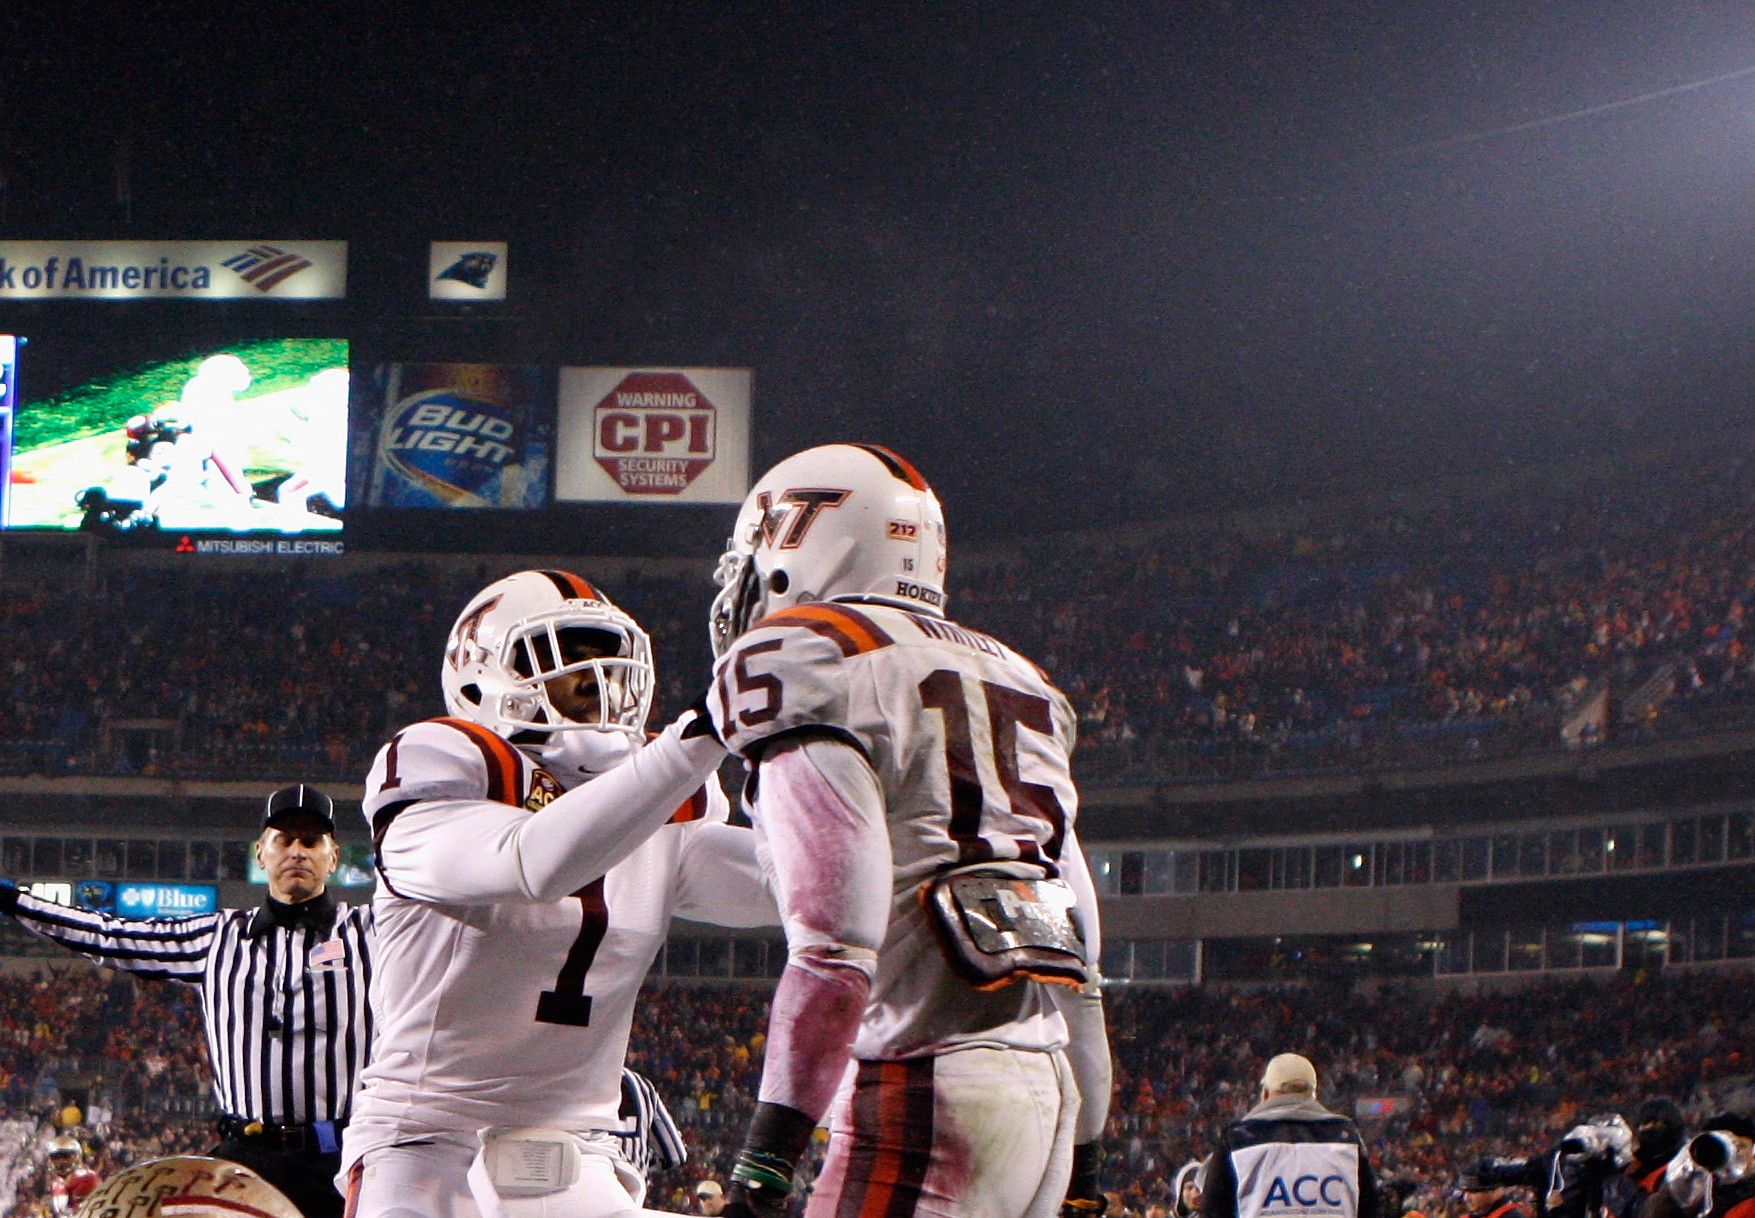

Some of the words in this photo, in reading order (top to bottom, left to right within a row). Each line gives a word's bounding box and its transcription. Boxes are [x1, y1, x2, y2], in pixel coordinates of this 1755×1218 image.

[22, 256, 59, 290] of
[62, 256, 212, 290] America
[617, 392, 697, 409] WARNING
[409, 404, 515, 442] BUD
[600, 412, 710, 453] CPI
[385, 426, 515, 463] LIGHT
[618, 460, 689, 474] SECURITY
[619, 473, 689, 489] SYSTEMS
[197, 540, 274, 553] MITSUBISHI
[278, 541, 345, 554] ELECTRIC
[720, 638, 786, 743] 15
[919, 669, 1069, 862] 15
[156, 888, 208, 908] Blue
[1262, 1175, 1343, 1208] ACC
